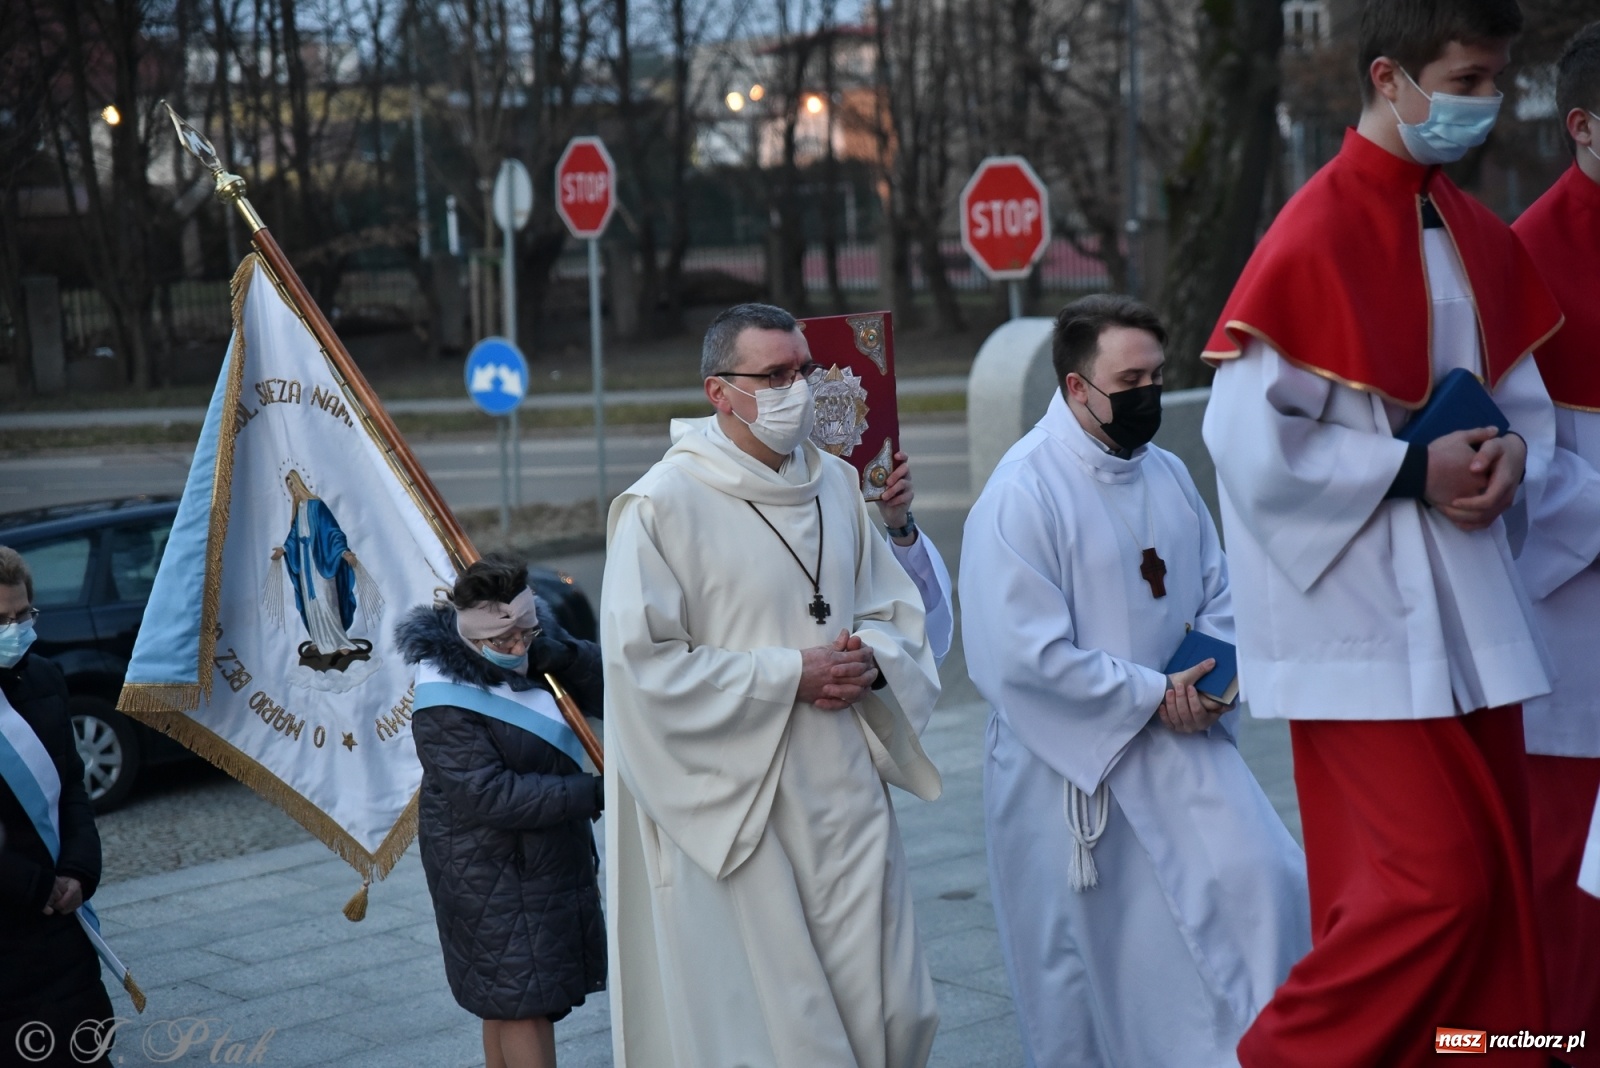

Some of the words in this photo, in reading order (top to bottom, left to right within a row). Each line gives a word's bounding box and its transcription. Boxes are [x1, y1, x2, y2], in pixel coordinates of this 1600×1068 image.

[562, 172, 608, 204] STOP
[971, 198, 1040, 238] STOP
[213, 648, 253, 693] BEZ
[249, 690, 306, 742] MARIO
[313, 725, 326, 749] O
